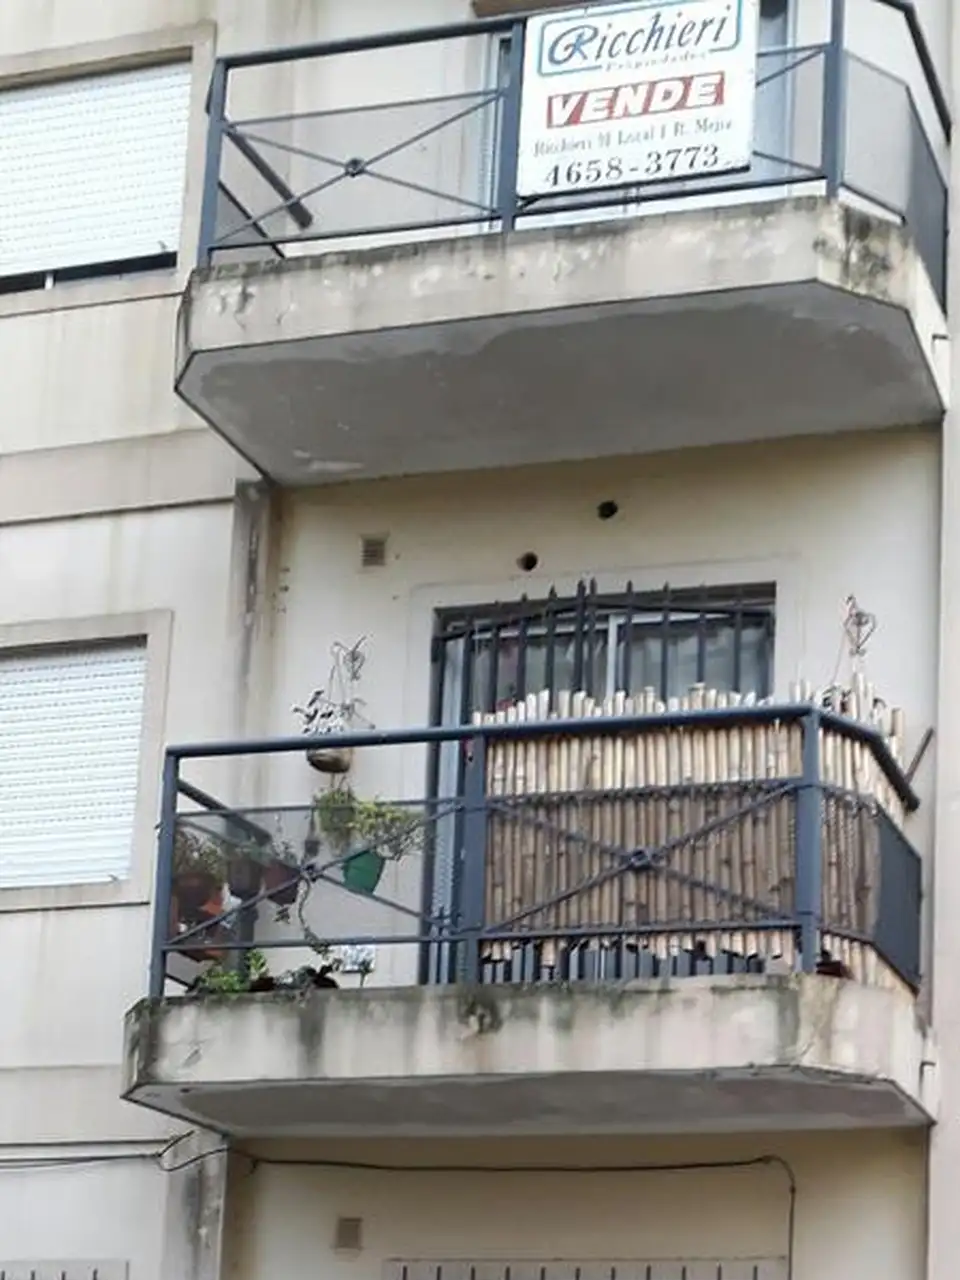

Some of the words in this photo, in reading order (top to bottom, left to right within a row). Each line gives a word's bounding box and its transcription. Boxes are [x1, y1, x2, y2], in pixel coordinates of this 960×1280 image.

[548, 4, 731, 65] Ricchieri
[549, 73, 722, 127] VENDE
[544, 143, 719, 186] 4658-3773
